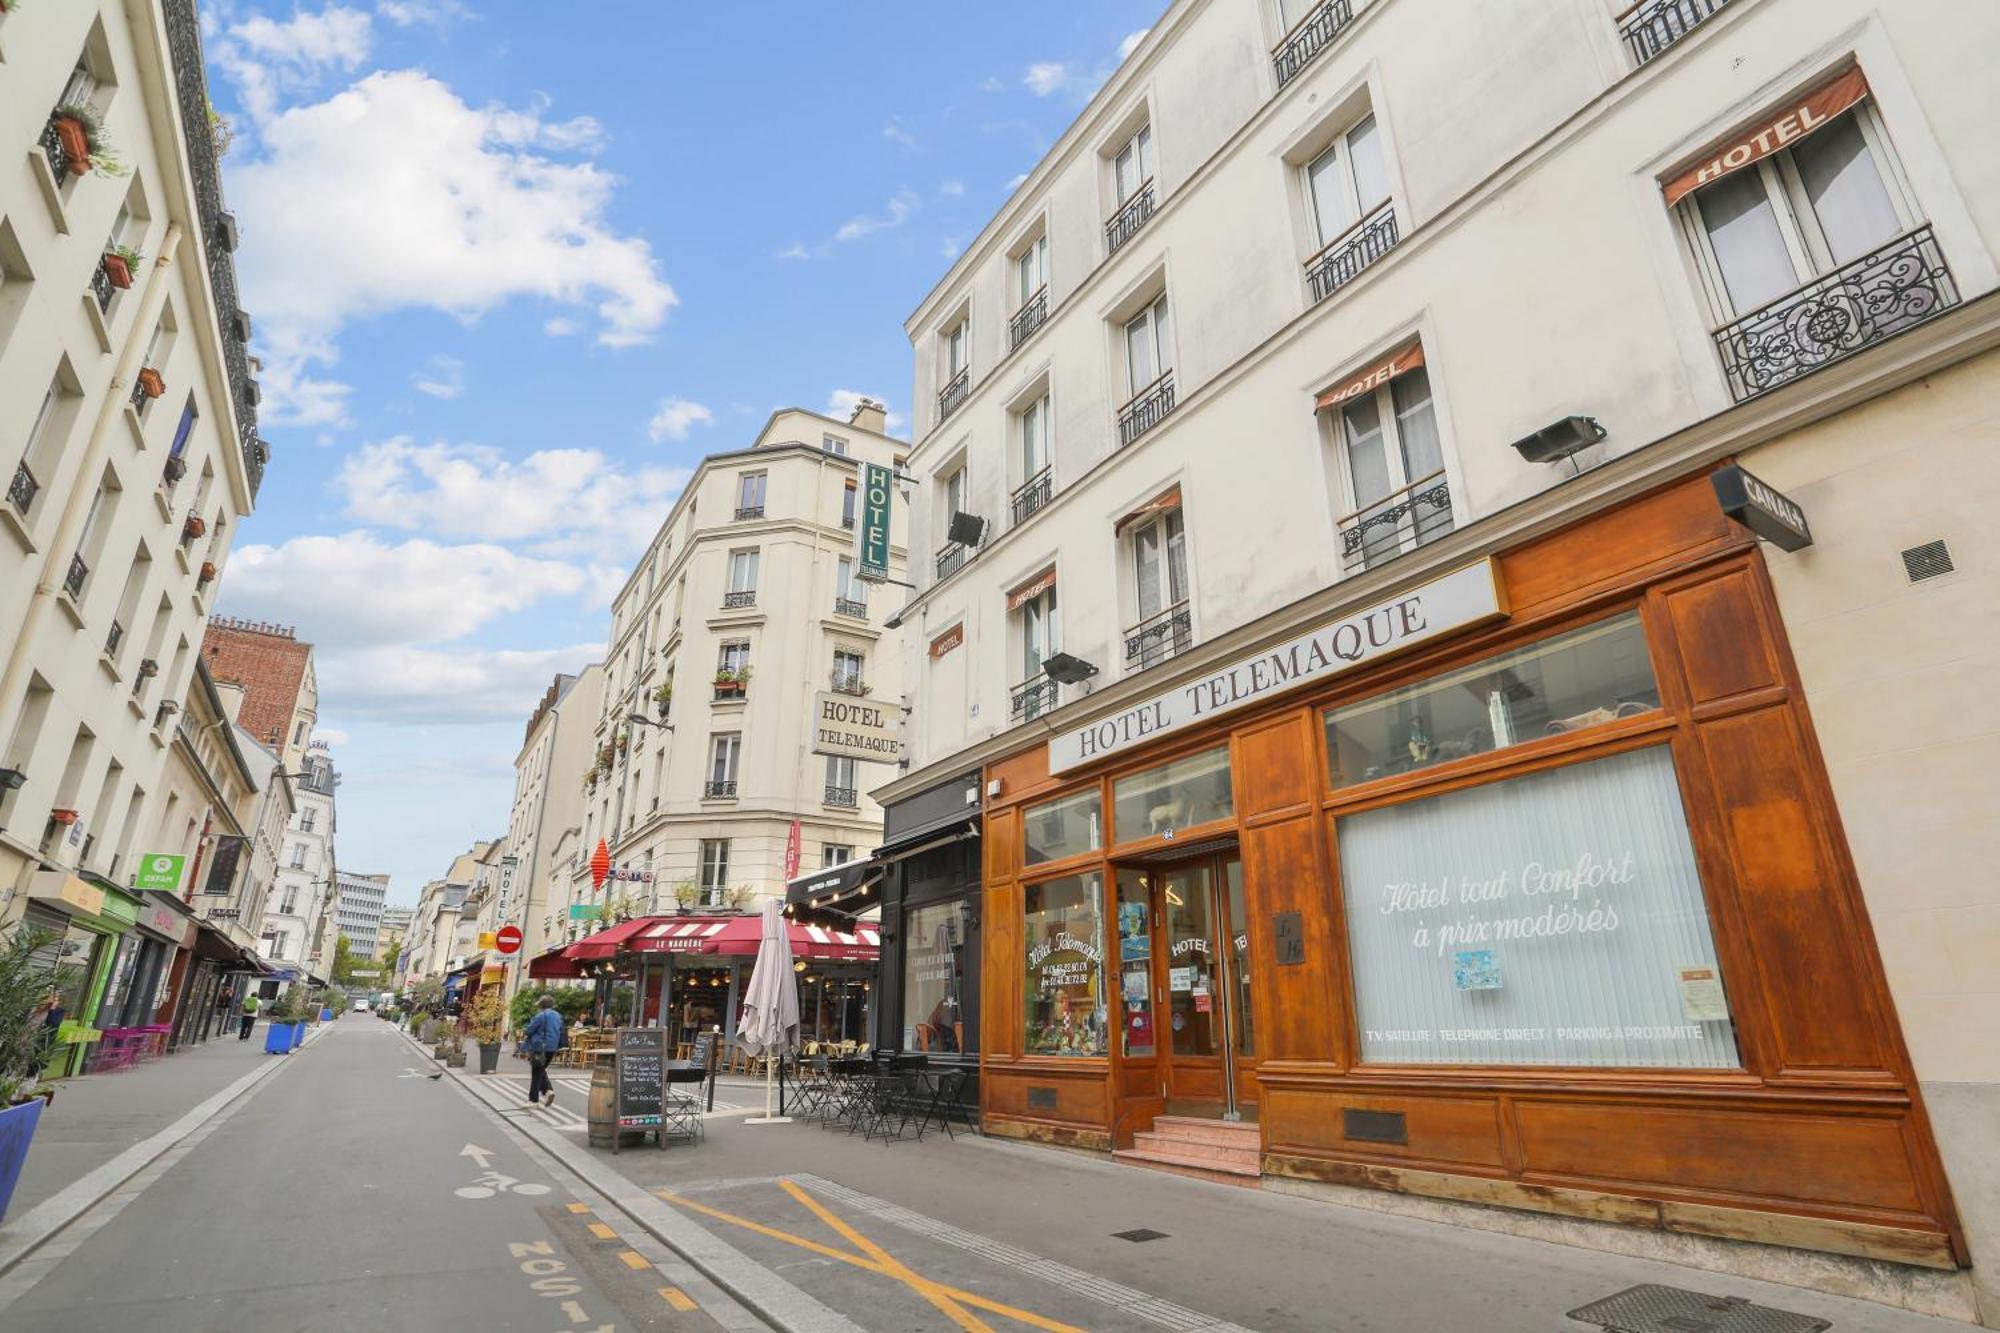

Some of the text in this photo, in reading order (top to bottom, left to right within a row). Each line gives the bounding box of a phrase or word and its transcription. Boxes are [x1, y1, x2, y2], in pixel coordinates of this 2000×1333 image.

[1697, 106, 1826, 183] HOTEL
[1329, 362, 1402, 403] HOTEL
[868, 468, 886, 565] HOTEL
[1743, 475, 1803, 531] CANAL+
[1015, 580, 1048, 607] HOTEL
[937, 635, 961, 655] HOTEL
[1079, 596, 1427, 758] HOTEL TELEMAQUE
[822, 701, 884, 728] HOTEL
[819, 729, 898, 753] TELEMAQUE
[497, 869, 512, 919] HOTEL
[1380, 851, 1634, 915] Hôtel tout Confort
[656, 940, 665, 948] LE
[1171, 938, 1209, 957] HOTEL
[1413, 900, 1619, 957] à prix modérés
[1505, 1027, 1545, 1041] DIRECT
[1557, 1025, 1611, 1040] PARKING
